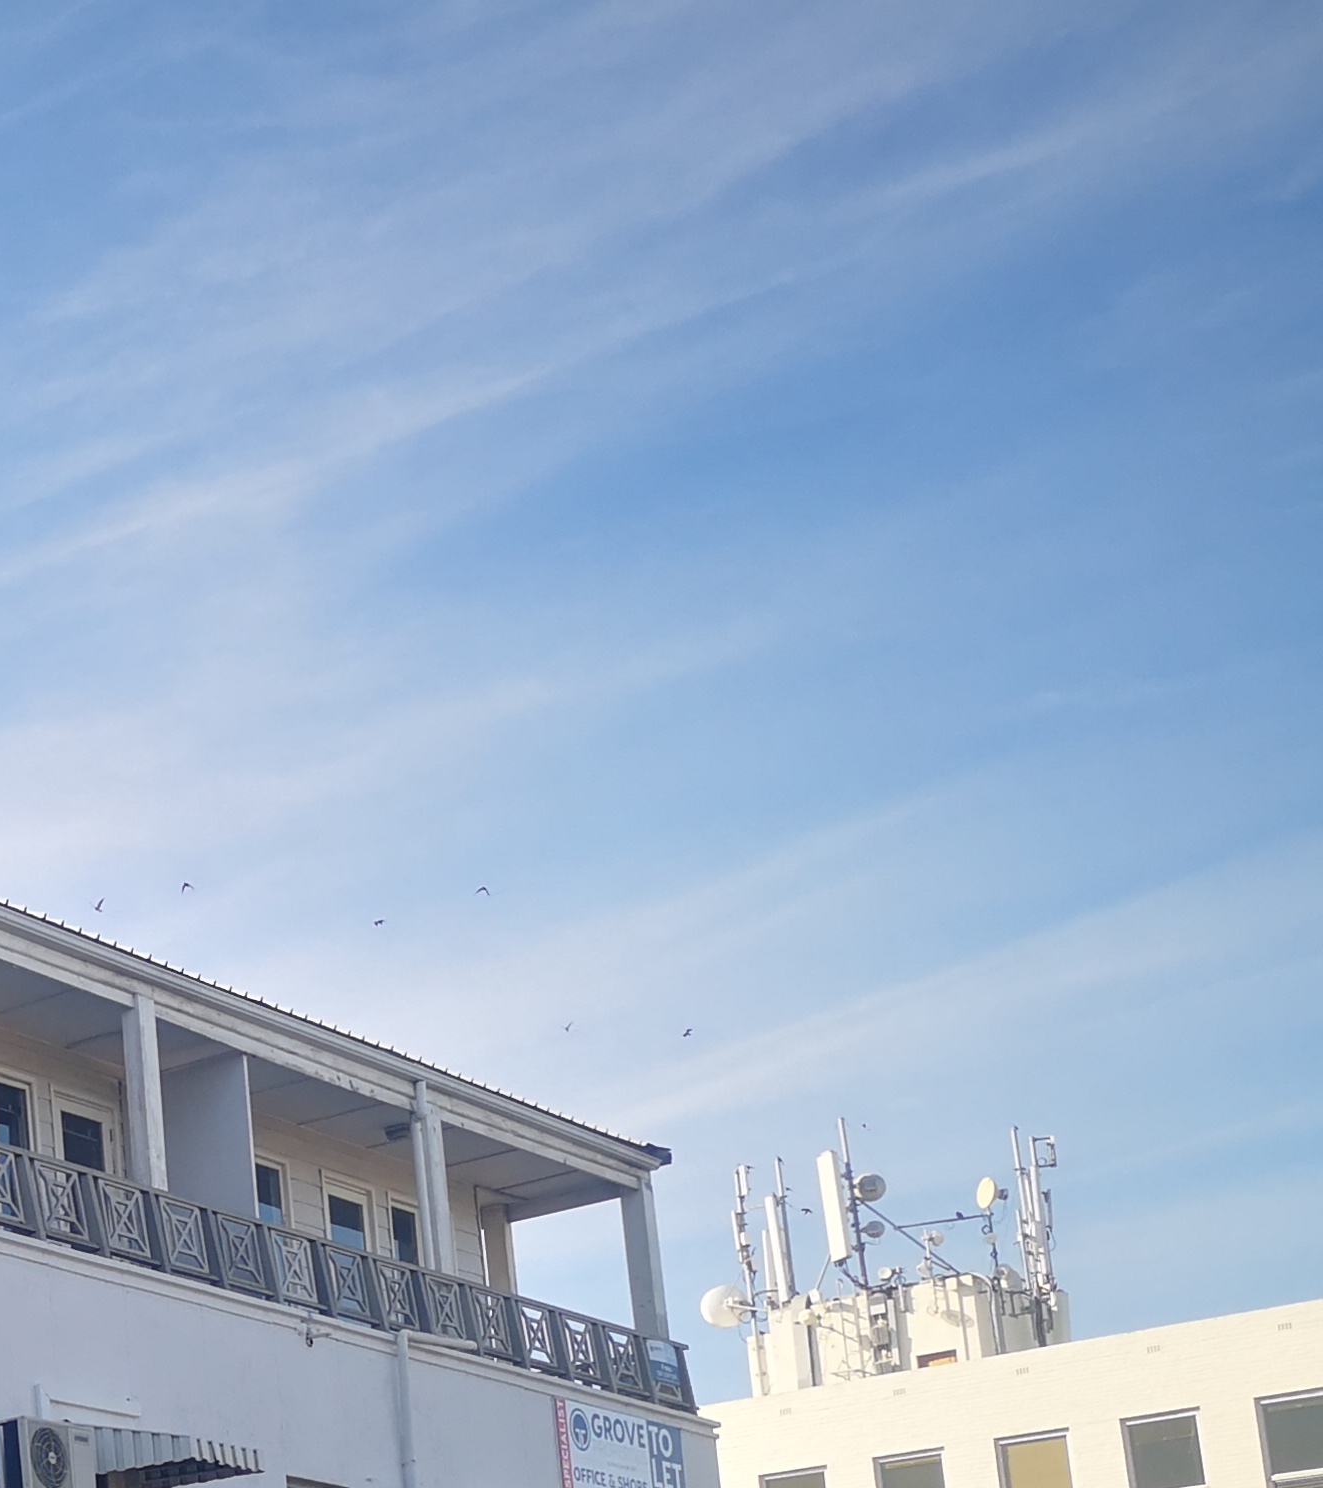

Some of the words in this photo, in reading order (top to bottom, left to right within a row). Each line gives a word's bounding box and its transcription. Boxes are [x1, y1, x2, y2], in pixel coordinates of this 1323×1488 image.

[556, 1400, 573, 1488] SPECIALIST
[591, 1413, 646, 1448] GROVE
[648, 1424, 673, 1458] TO
[573, 1466, 606, 1487] OFFICE
